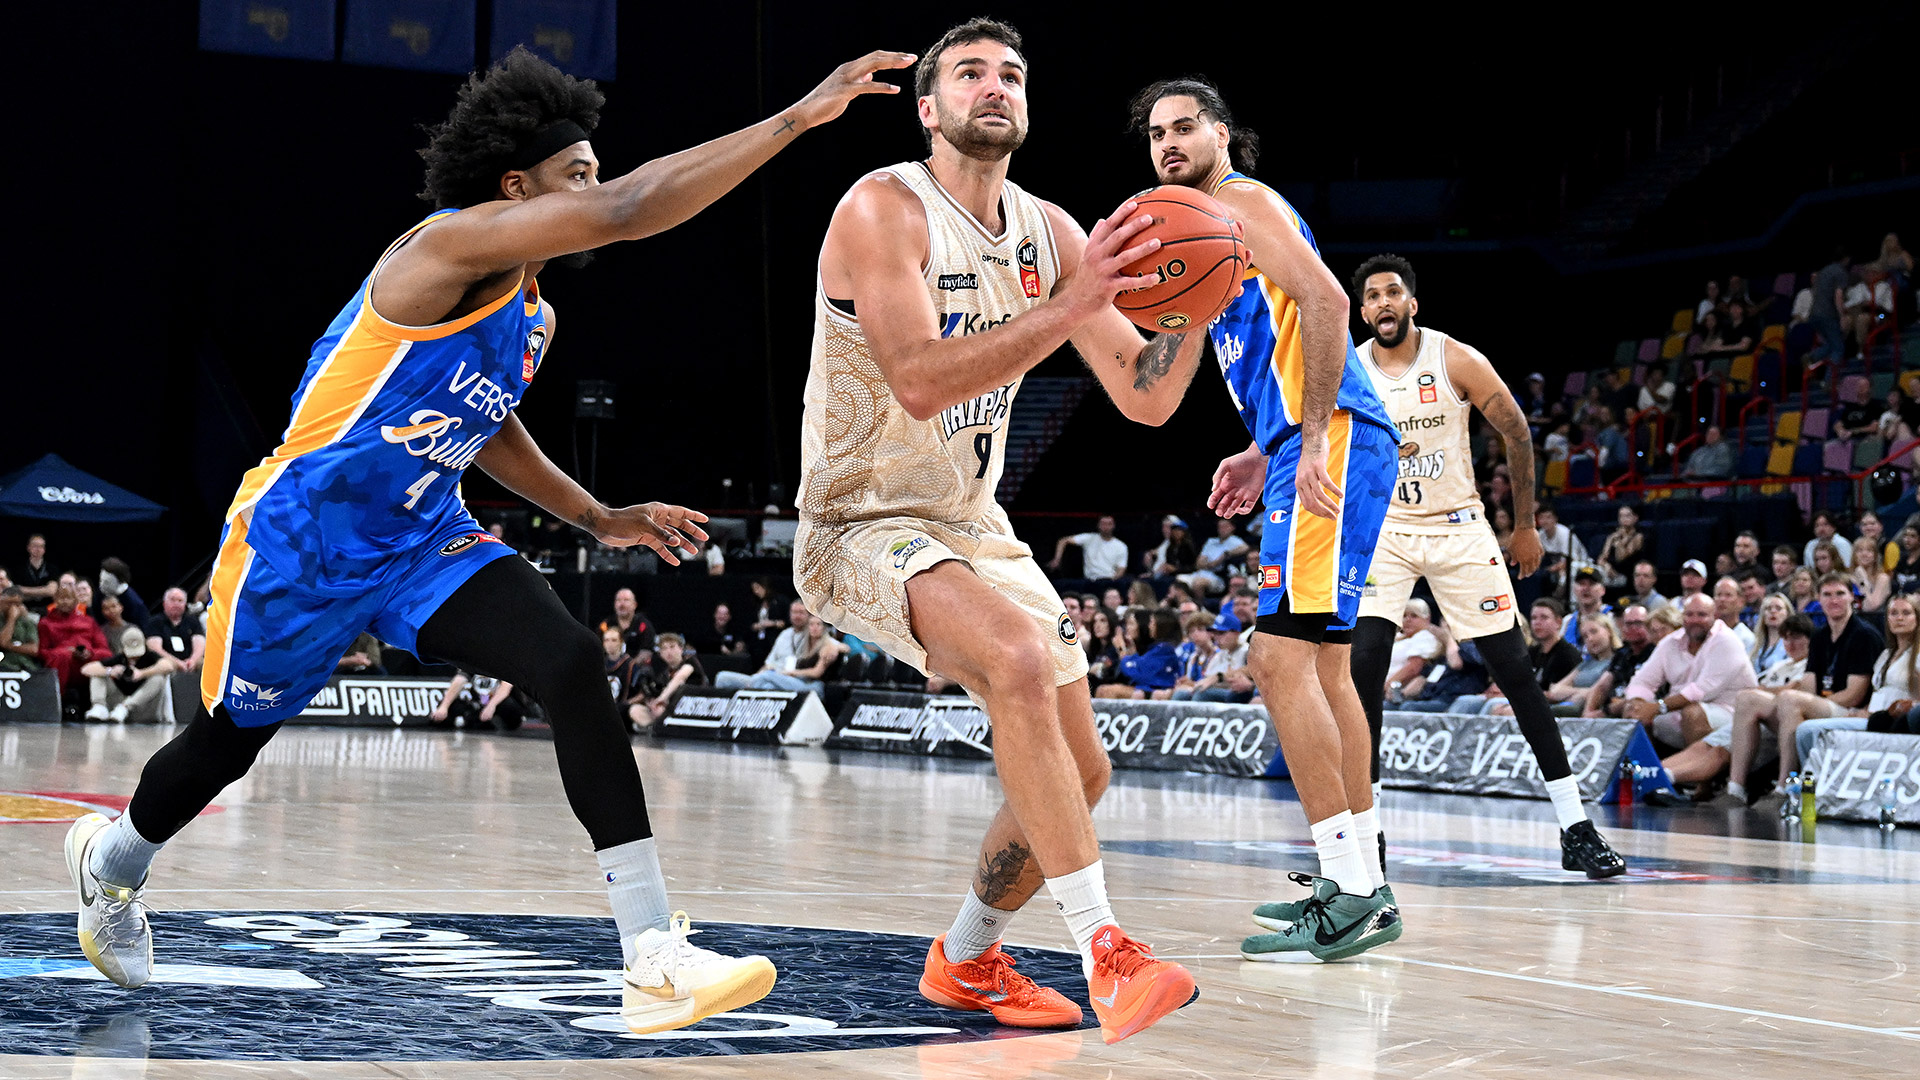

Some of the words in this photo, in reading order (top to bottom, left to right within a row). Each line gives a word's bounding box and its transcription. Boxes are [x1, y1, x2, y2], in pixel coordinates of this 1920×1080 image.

[982, 254, 1010, 267] OPTUS
[940, 275, 978, 290] myfield
[973, 433, 993, 479] 9
[38, 486, 105, 504] Coors
[402, 470, 441, 511] 4
[1398, 481, 1423, 504] 43
[1160, 717, 1267, 760] VERSO.
[1470, 732, 1603, 783] VERO.
